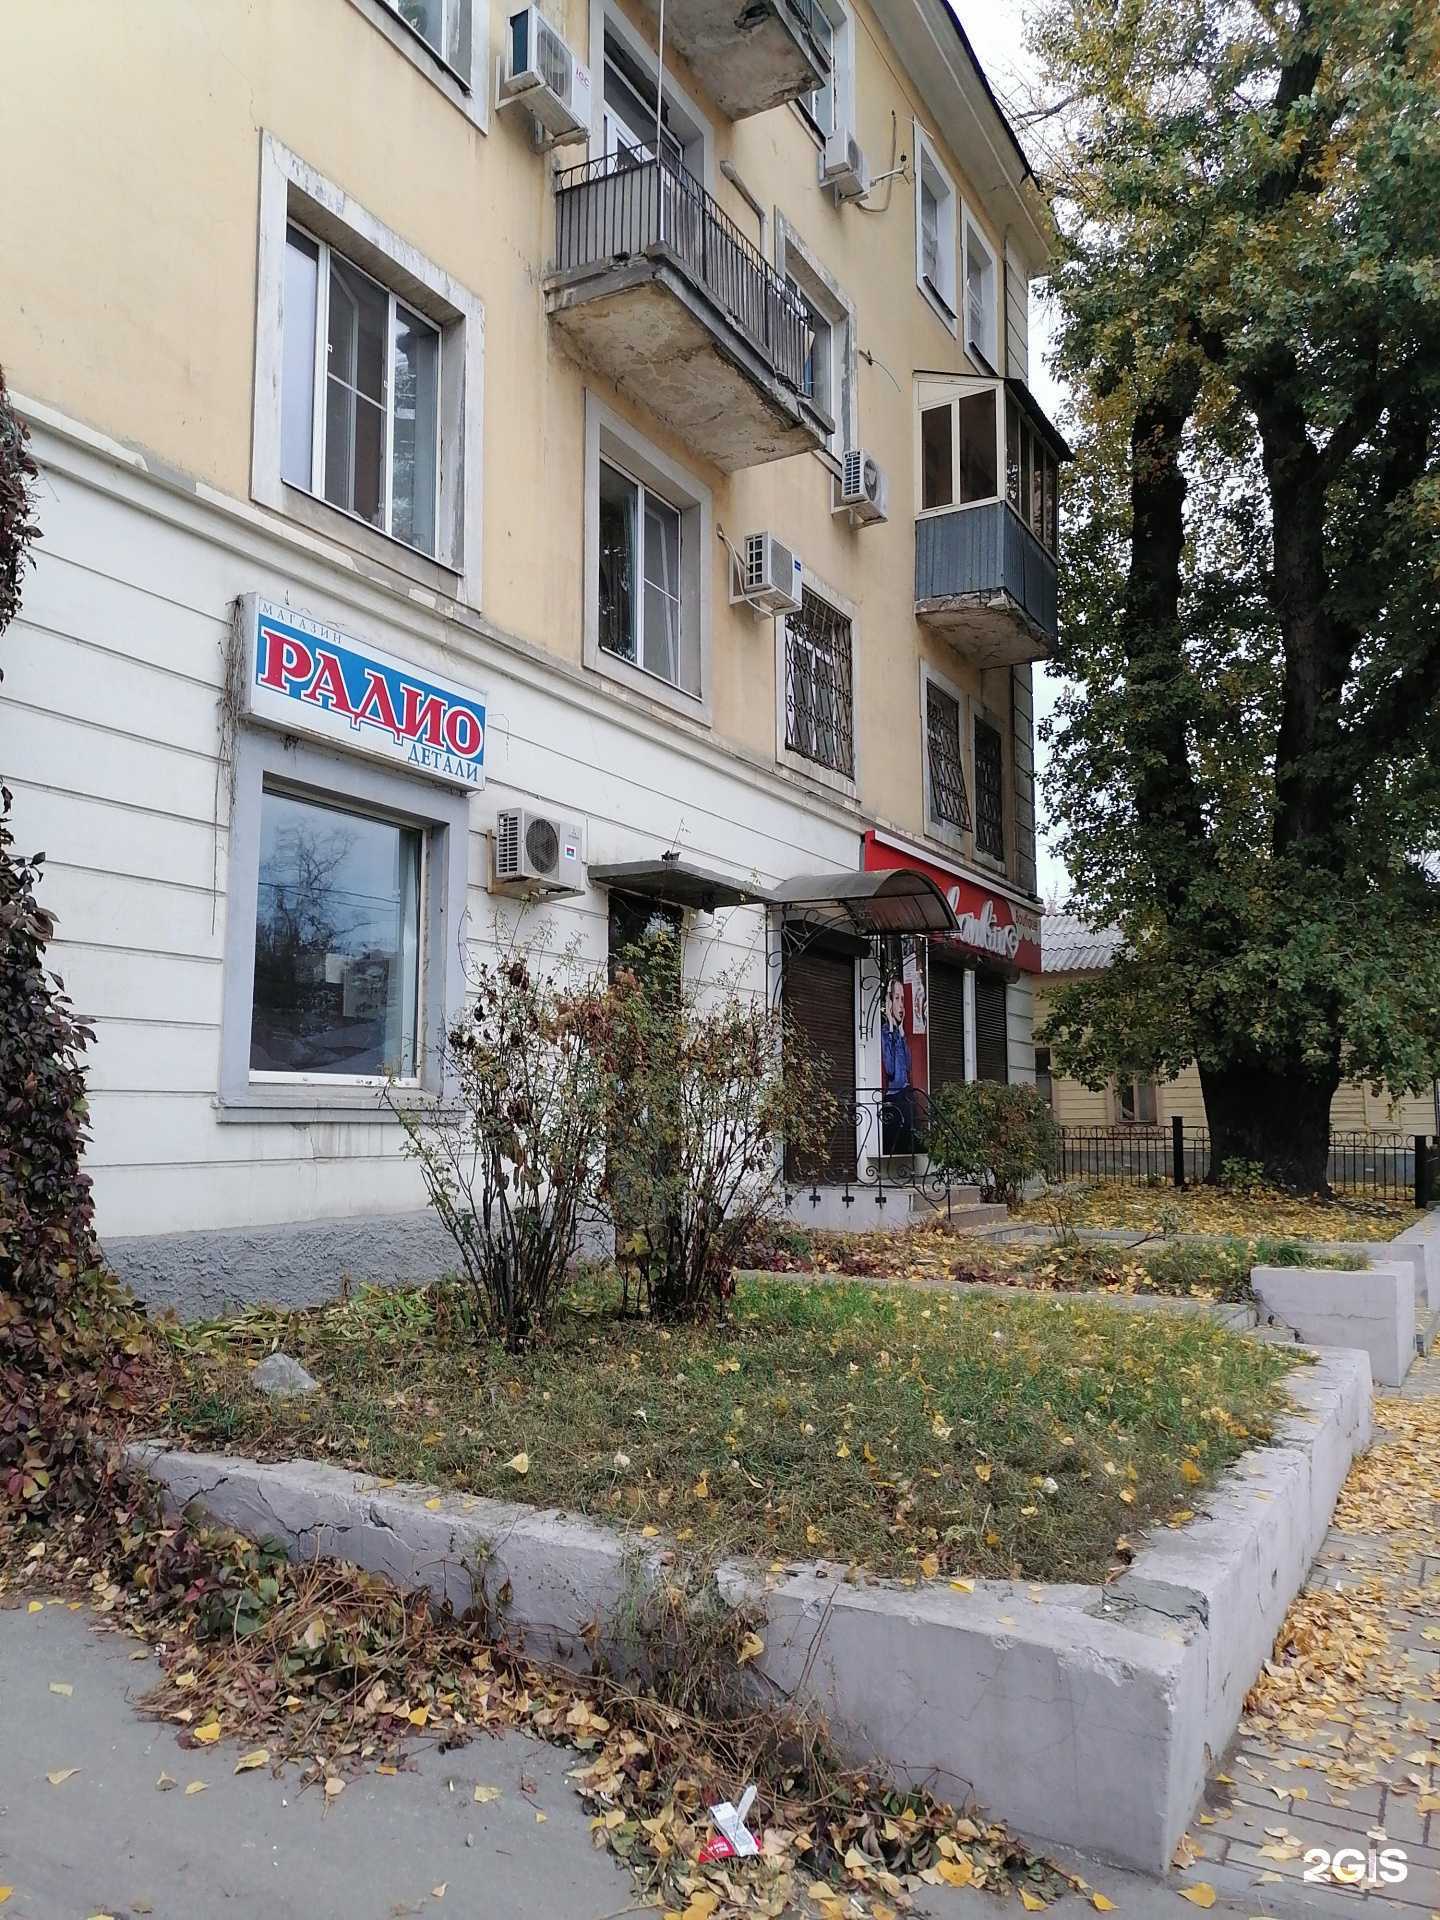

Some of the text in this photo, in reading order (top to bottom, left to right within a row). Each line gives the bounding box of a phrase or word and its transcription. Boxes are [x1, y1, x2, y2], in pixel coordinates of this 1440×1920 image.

[263, 603, 342, 644] МАГАЗИН
[259, 627, 485, 758] РАДИО
[408, 743, 478, 782] ДЕТАЛИ
